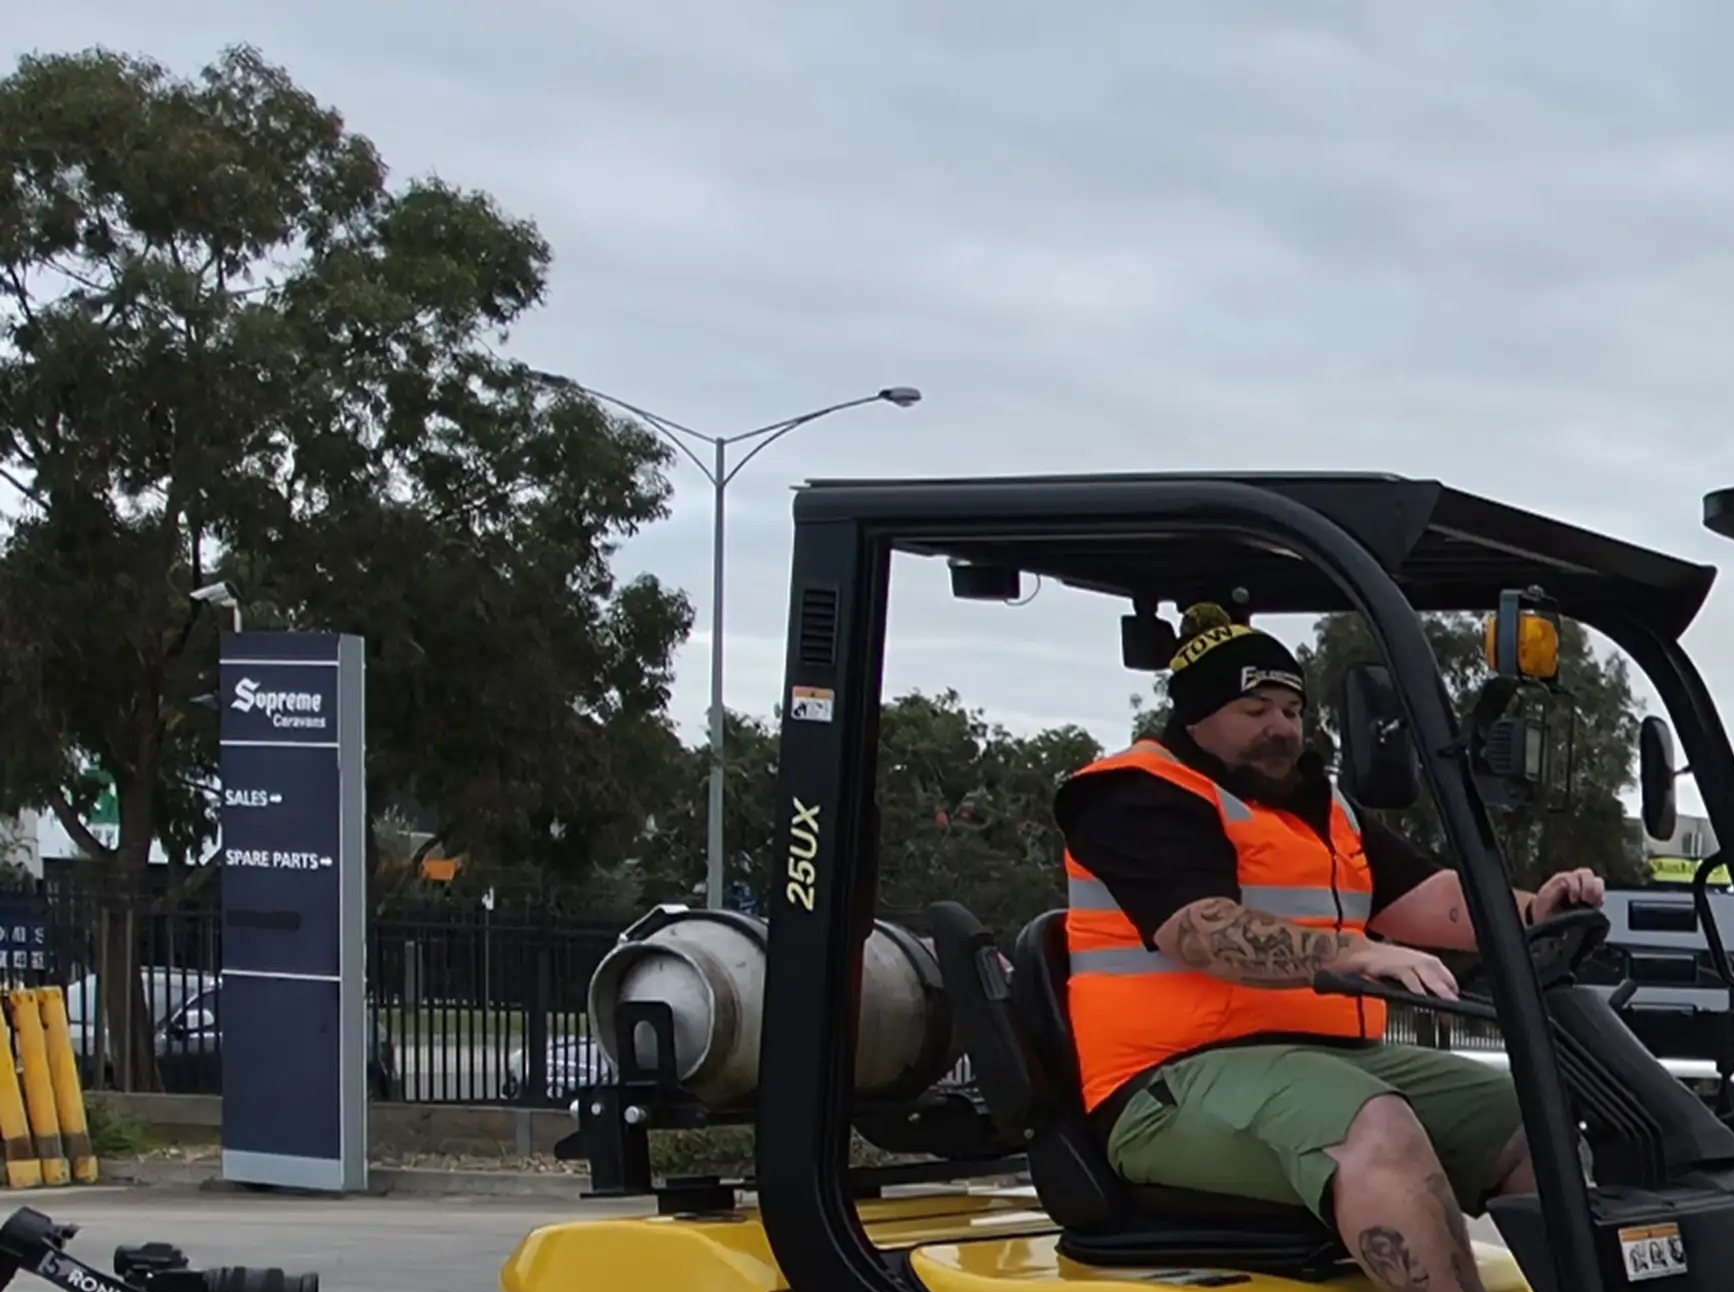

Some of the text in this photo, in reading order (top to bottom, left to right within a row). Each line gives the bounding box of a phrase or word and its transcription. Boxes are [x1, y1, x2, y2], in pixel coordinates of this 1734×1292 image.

[1179, 625, 1233, 666] TOW
[225, 789, 267, 806] SALES
[226, 849, 318, 869] SPARE PARTS
[787, 797, 820, 911] 25UX
